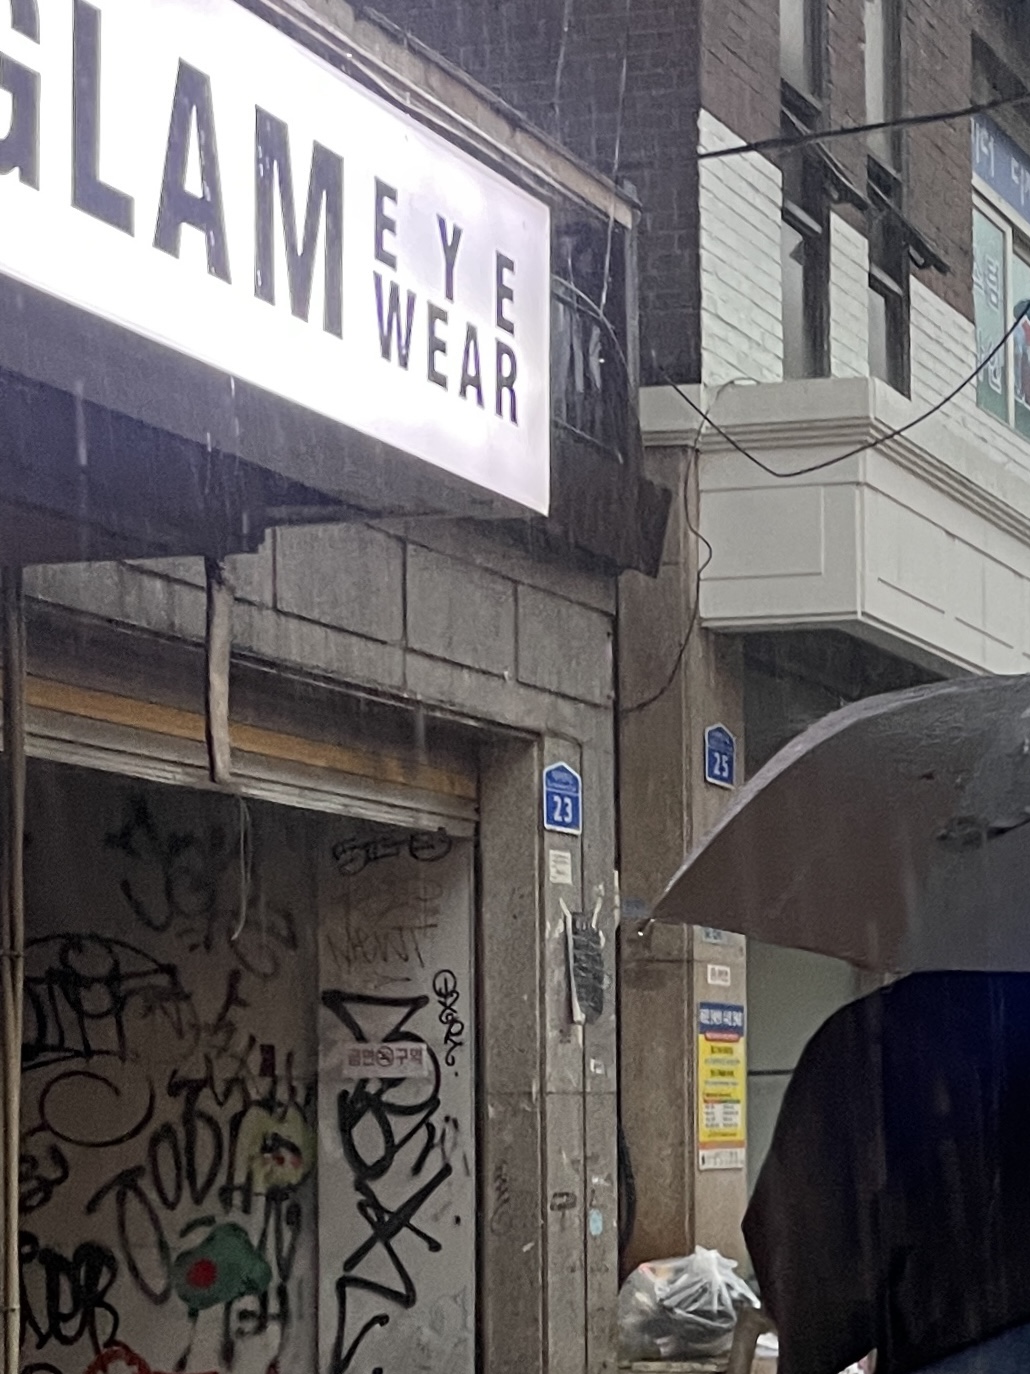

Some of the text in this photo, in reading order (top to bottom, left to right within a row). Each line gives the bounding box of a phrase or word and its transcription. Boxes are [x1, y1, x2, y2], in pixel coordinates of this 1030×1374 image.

[373, 270, 519, 427] WEAR
[713, 752, 729, 778] 25
[553, 795, 572, 823] 23
